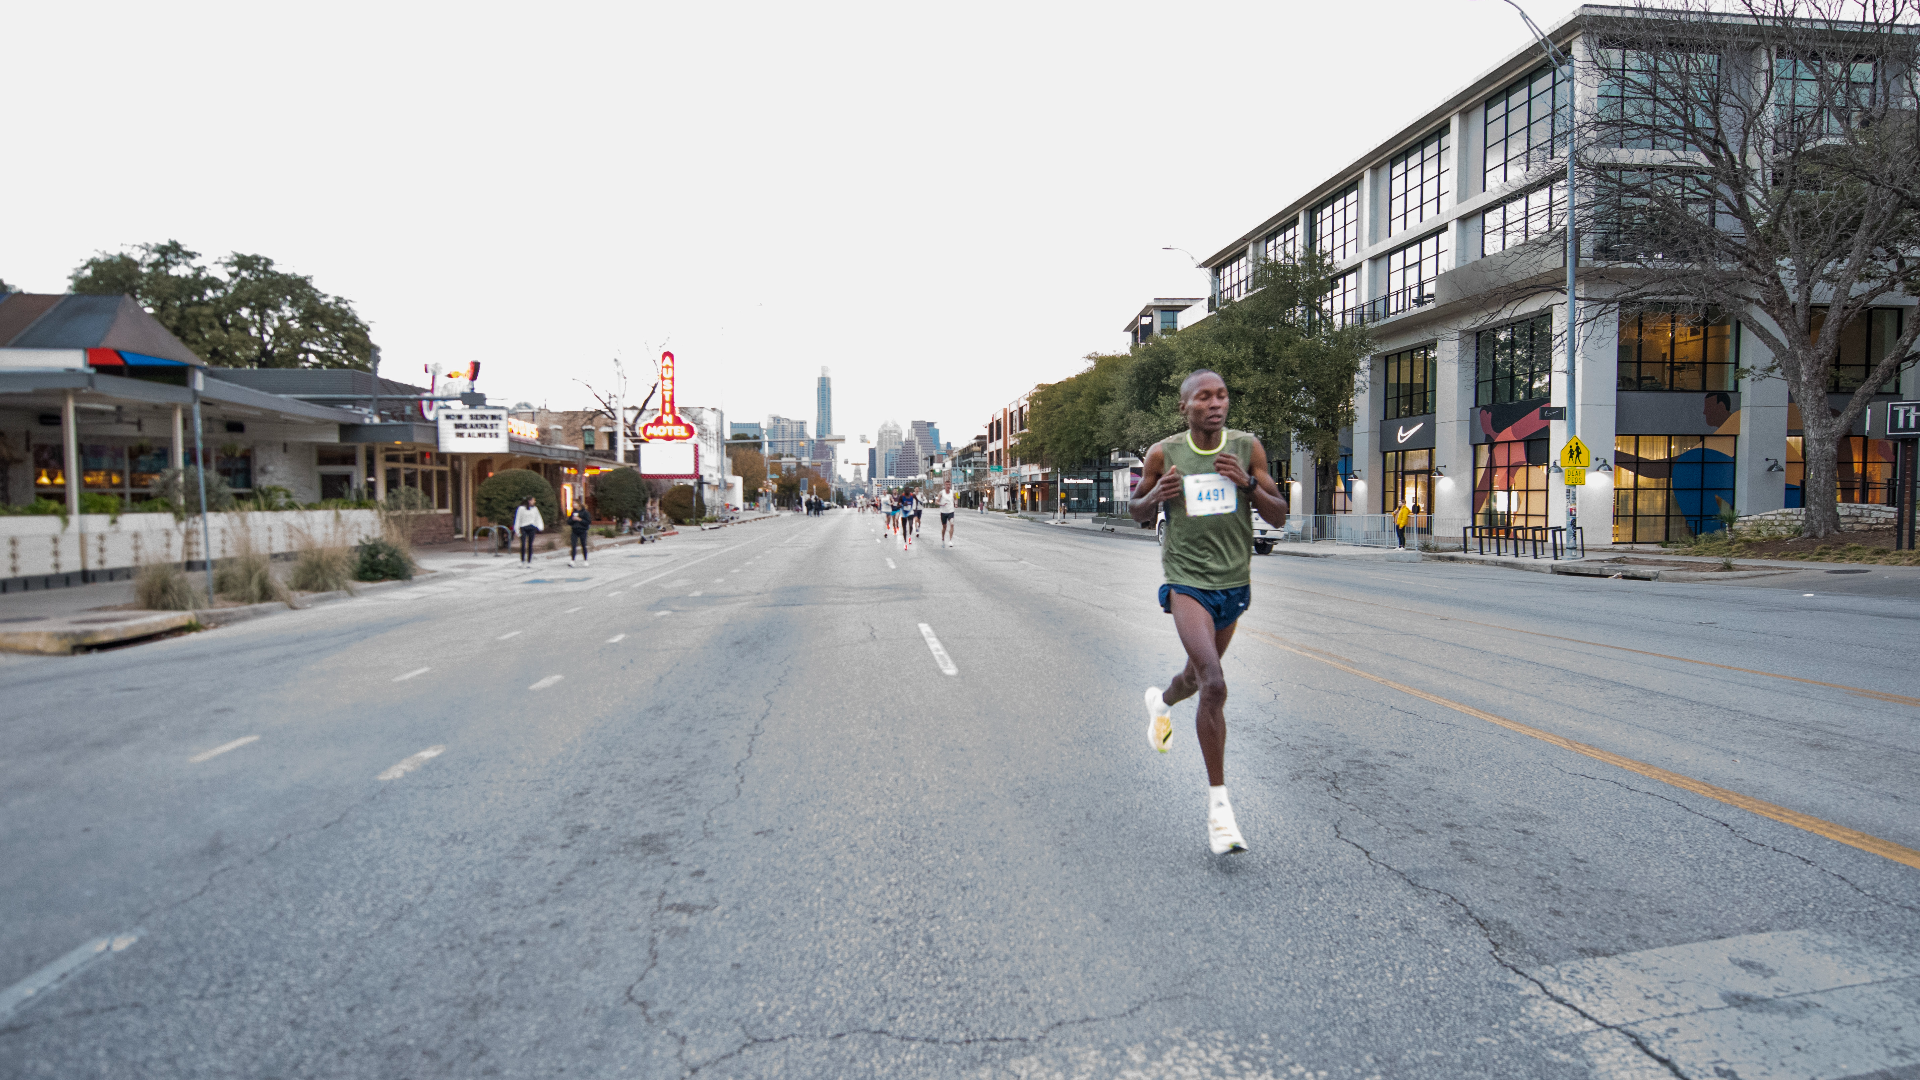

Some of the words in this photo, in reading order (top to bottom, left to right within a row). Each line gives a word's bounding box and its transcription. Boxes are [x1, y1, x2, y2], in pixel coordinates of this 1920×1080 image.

[662, 355, 673, 424] AUSTIN
[646, 425, 689, 437] MOTEL
[1197, 487, 1225, 502] 4491
